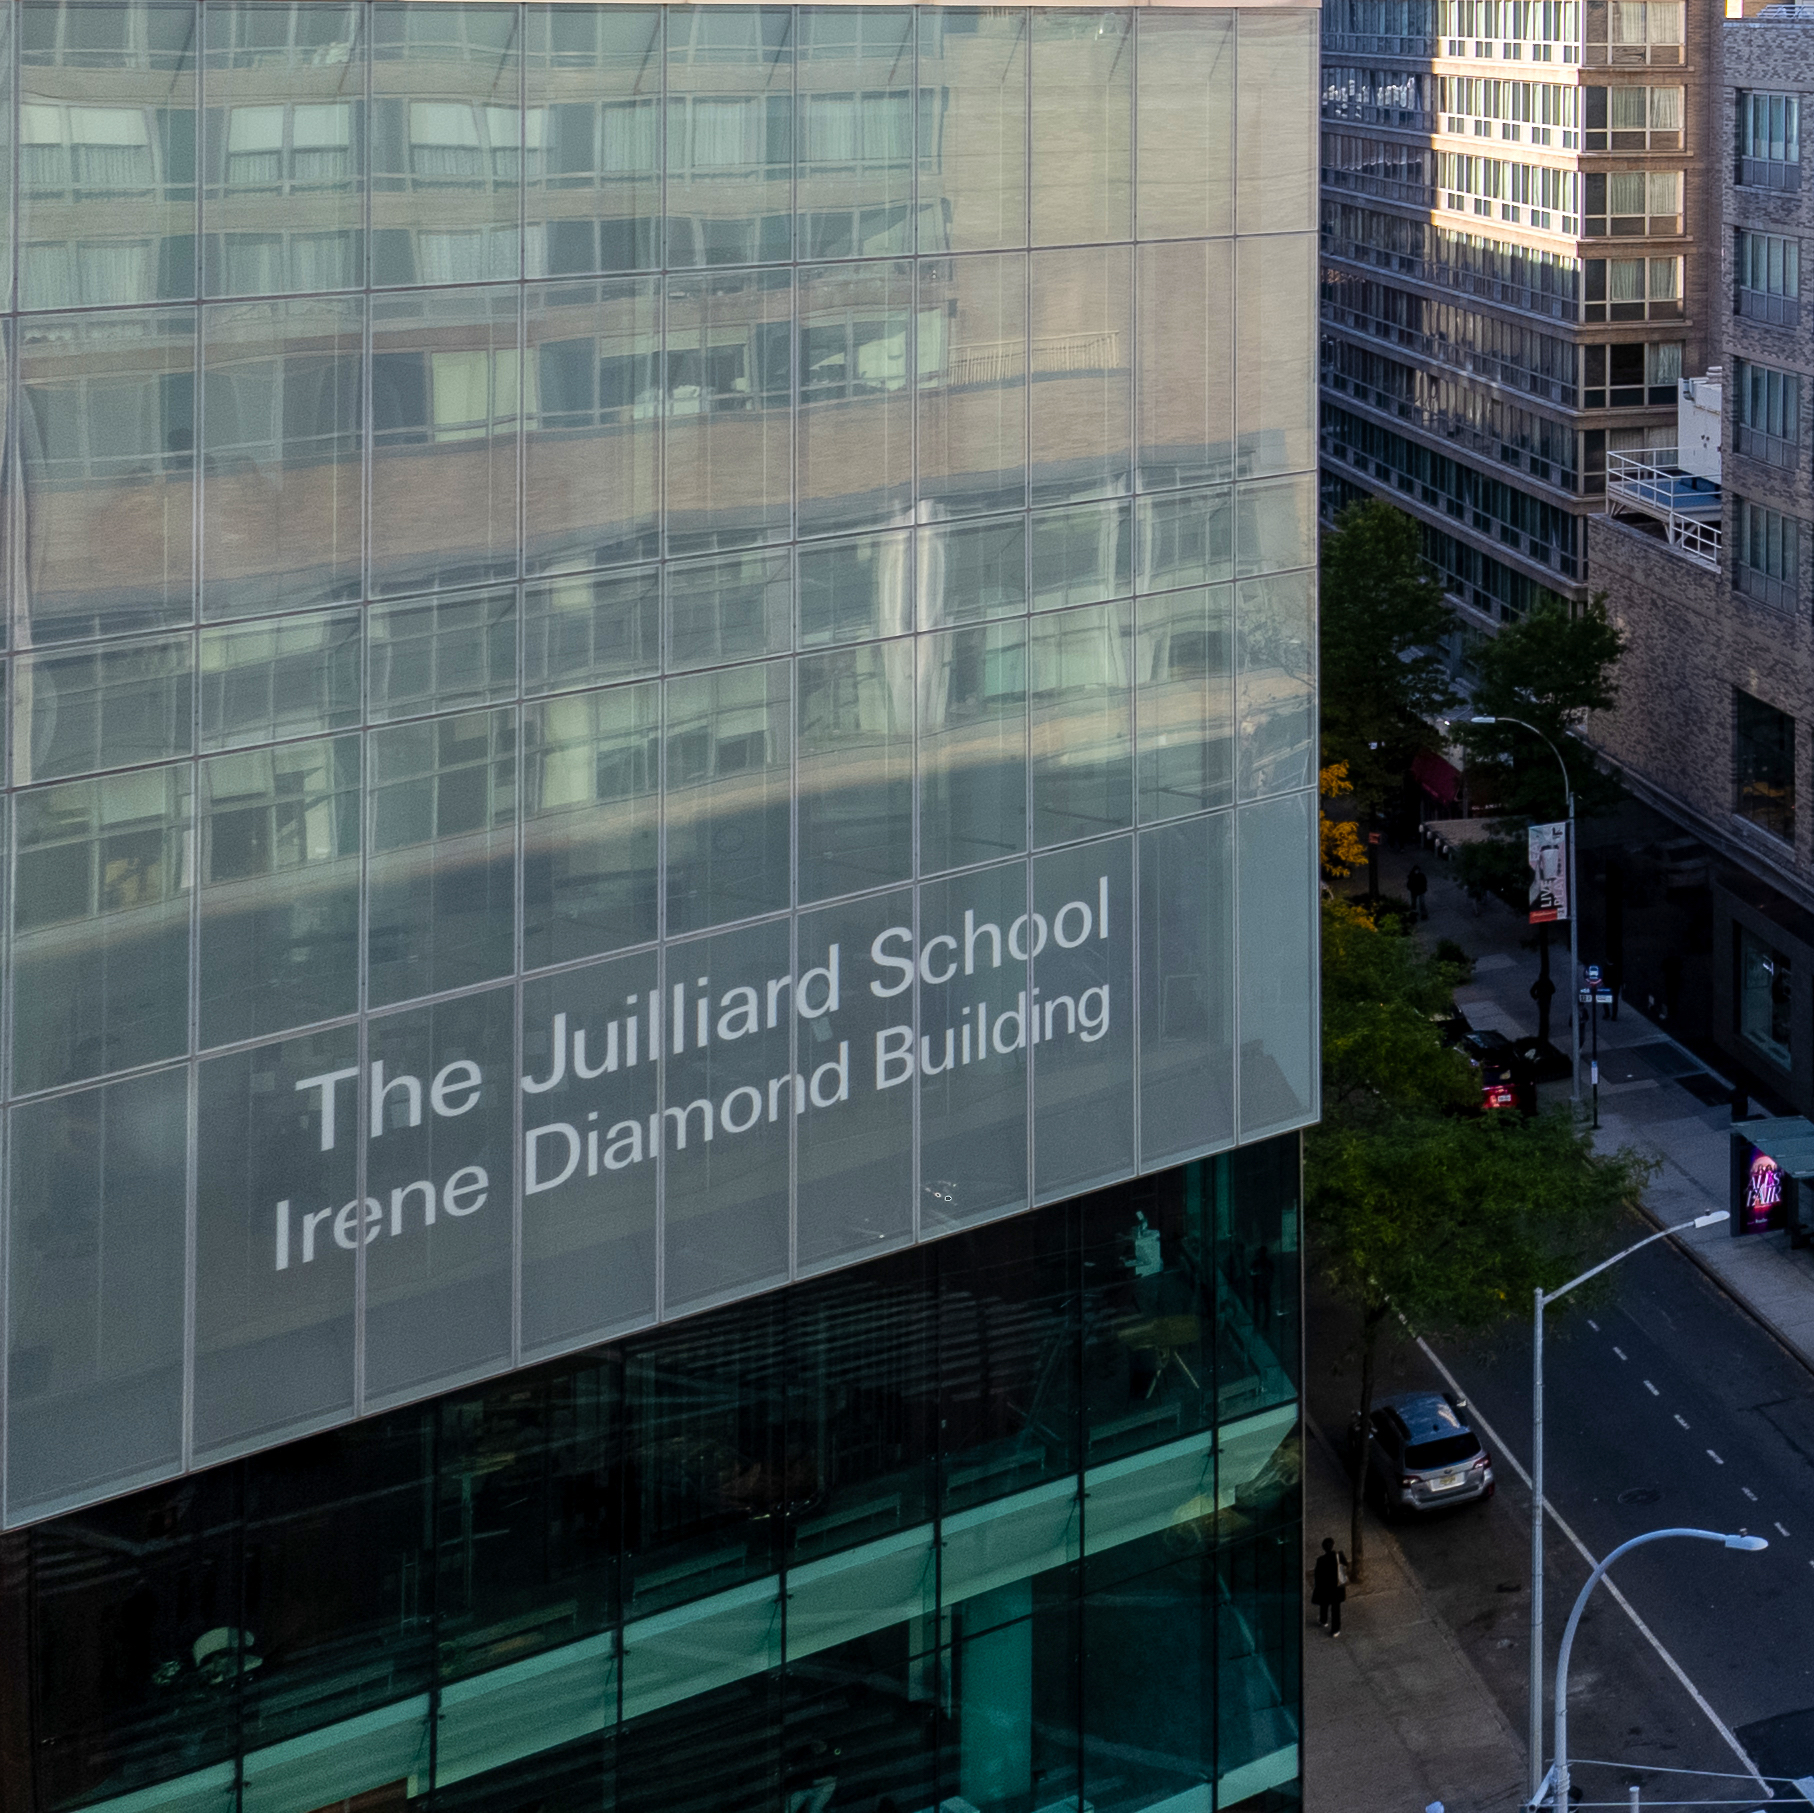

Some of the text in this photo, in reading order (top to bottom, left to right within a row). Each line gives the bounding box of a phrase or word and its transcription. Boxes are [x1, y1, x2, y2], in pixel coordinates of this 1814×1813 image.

[275, 984, 1112, 1271] Irene Diamond Building
[295, 874, 1111, 1154] The Juilliard School
